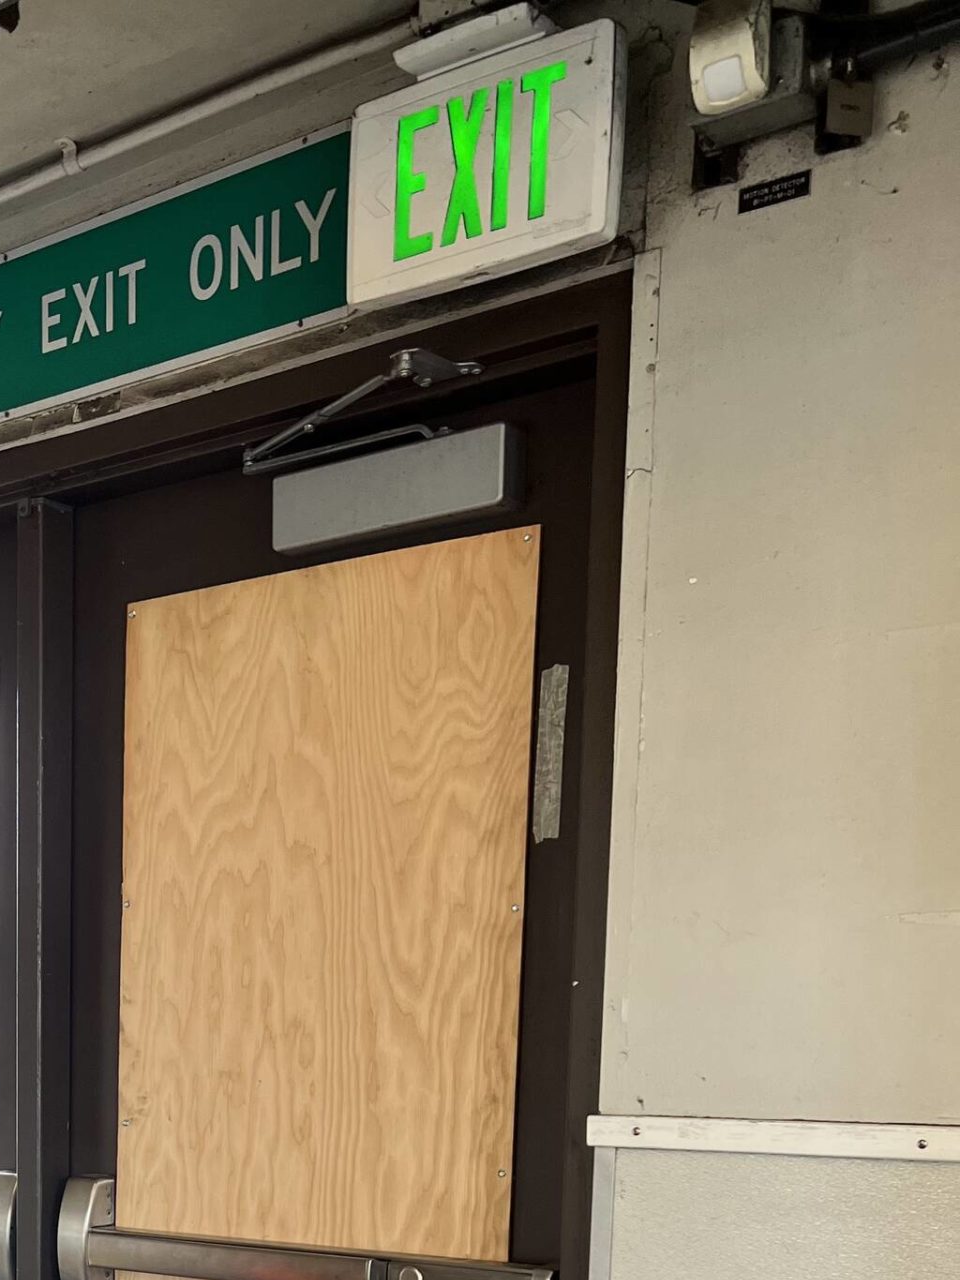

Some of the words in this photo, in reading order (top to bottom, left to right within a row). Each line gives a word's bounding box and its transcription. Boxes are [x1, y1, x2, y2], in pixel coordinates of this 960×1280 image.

[394, 61, 567, 260] EXIT
[41, 259, 146, 354] EXIT
[189, 189, 336, 301] ONLY
